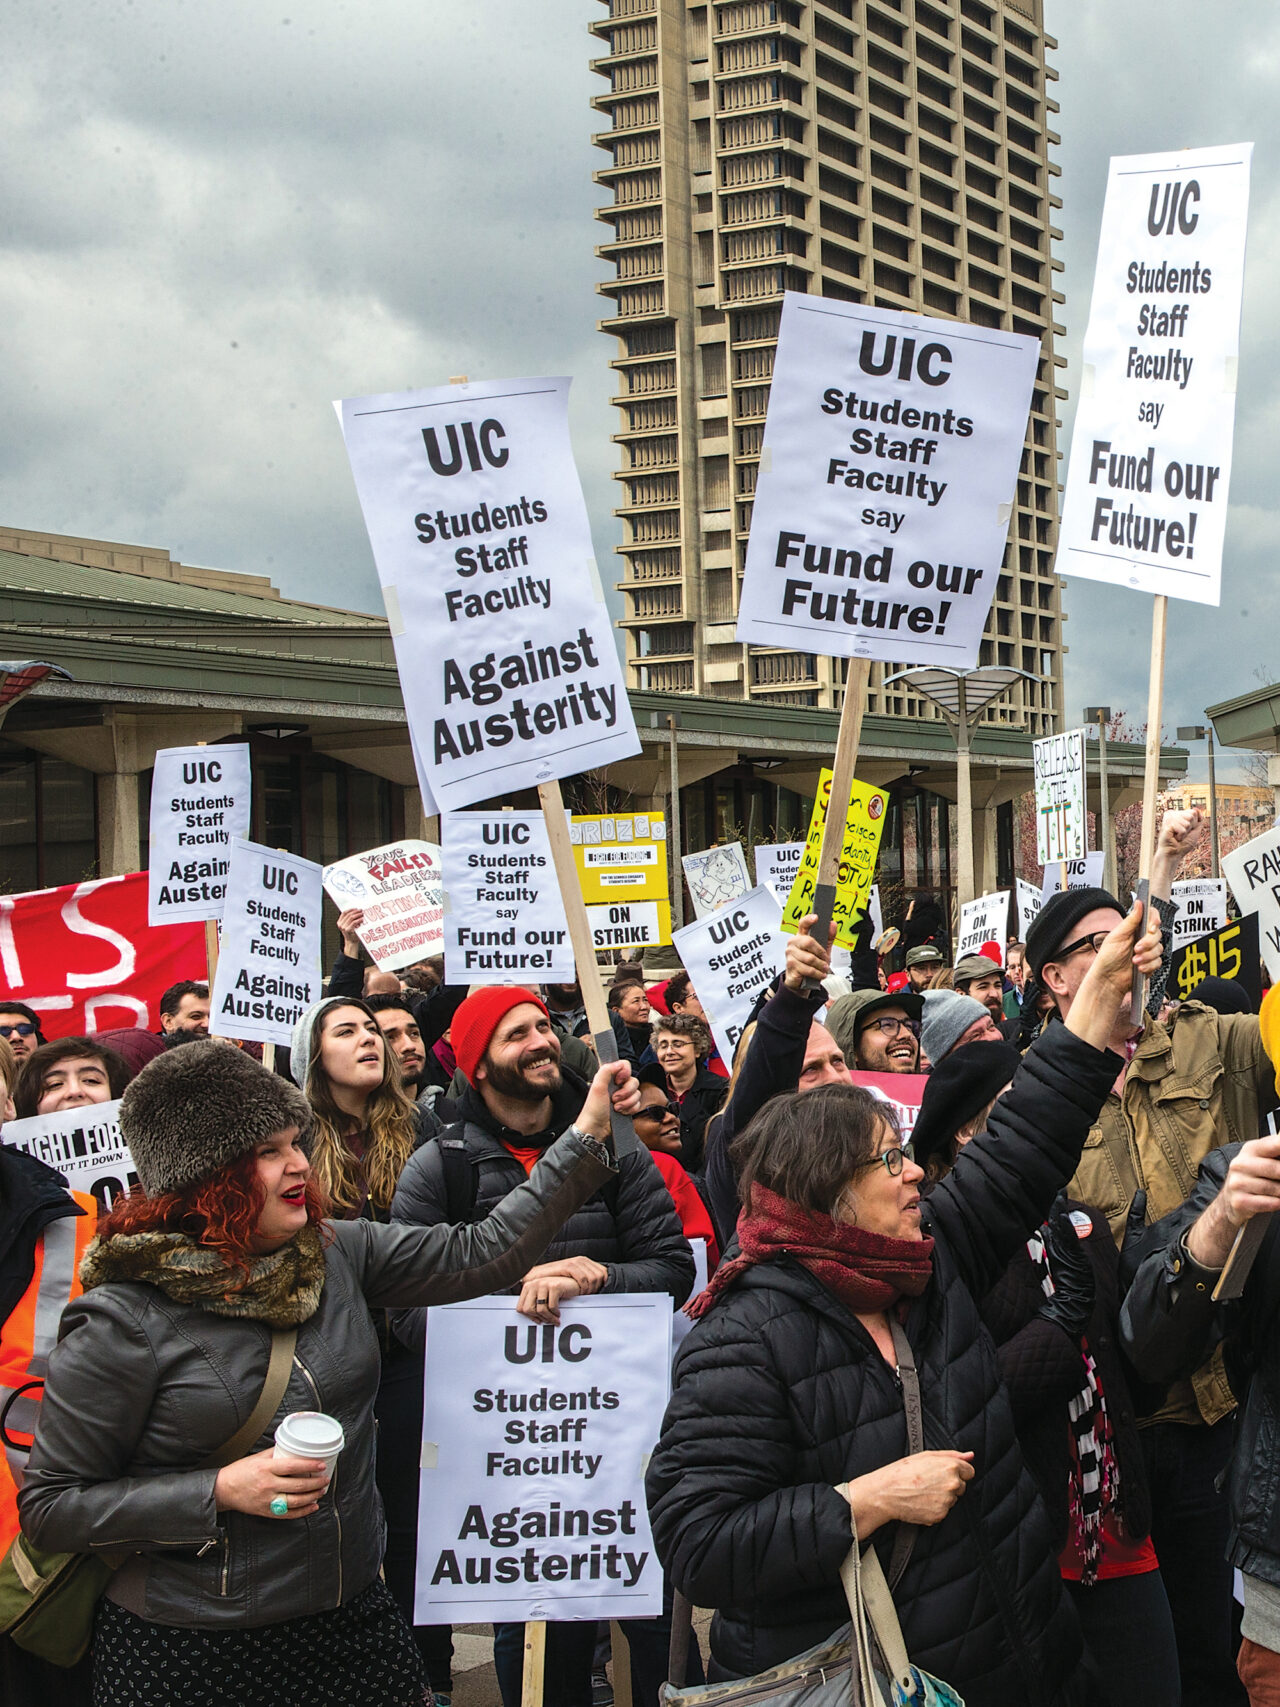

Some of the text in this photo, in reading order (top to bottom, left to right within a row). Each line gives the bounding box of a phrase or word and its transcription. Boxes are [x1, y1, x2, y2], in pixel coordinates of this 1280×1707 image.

[1148, 180, 1200, 236] UIC
[1126, 261, 1211, 294] Students
[1138, 304, 1189, 337] Staff
[859, 331, 952, 386] UIC
[1127, 347, 1193, 390] Faculty
[821, 388, 973, 437] Students
[1138, 402, 1164, 429] say
[422, 419, 509, 476] UIC
[850, 428, 938, 465] Staff
[827, 458, 948, 506] Faculty
[1089, 440, 1220, 502] Fund our
[415, 496, 547, 544] Students
[861, 509, 905, 534] say
[1091, 498, 1197, 559] Future!
[455, 536, 528, 577] Staff
[775, 531, 983, 594] Fund our
[445, 576, 550, 622] Faculty
[782, 579, 952, 638] Future!
[442, 628, 599, 706] Against
[434, 682, 618, 765] Austerity
[1034, 734, 1081, 779] RELEASE
[184, 761, 222, 784] UIC
[171, 795, 234, 812] Students
[1051, 780, 1068, 805] THE
[186, 812, 224, 828] Staff
[483, 823, 530, 844] UIC
[179, 830, 229, 846] Faculty
[810, 831, 820, 843] in
[360, 848, 406, 868] YOUR
[368, 852, 433, 881] FAILED
[468, 854, 546, 867] Students
[777, 850, 800, 862] UIC
[169, 858, 230, 883] Again
[263, 864, 298, 895] UIC
[485, 871, 529, 884] Staff
[158, 882, 227, 905] Auster
[362, 892, 429, 923] URTING
[477, 888, 538, 903] Faculty
[1188, 900, 1203, 914] ON
[246, 900, 306, 928] Students
[496, 910, 518, 920] say
[610, 907, 630, 923] ON
[708, 909, 749, 944] UIC
[973, 914, 986, 930] ON
[1174, 917, 1218, 934] STRIKE
[260, 922, 295, 942] Staff
[458, 927, 565, 946] Fund our
[594, 926, 649, 945] STRIKE
[962, 928, 997, 950] STRIKE
[251, 939, 300, 966] Faculty
[465, 950, 552, 968] Future!
[708, 932, 771, 971] Students
[728, 951, 764, 979] Staff
[1177, 926, 1241, 1000] $15
[235, 969, 310, 1003] Against
[726, 964, 777, 999] Faculty
[222, 993, 303, 1025] Austerit
[53, 1152, 123, 1172] HUT IT DOWN
[504, 1323, 592, 1365] UIC
[473, 1387, 619, 1412] Students
[504, 1418, 587, 1444] Staff
[486, 1450, 602, 1479] Faculty
[458, 1500, 636, 1548] Against
[430, 1544, 649, 1587] Austerity
